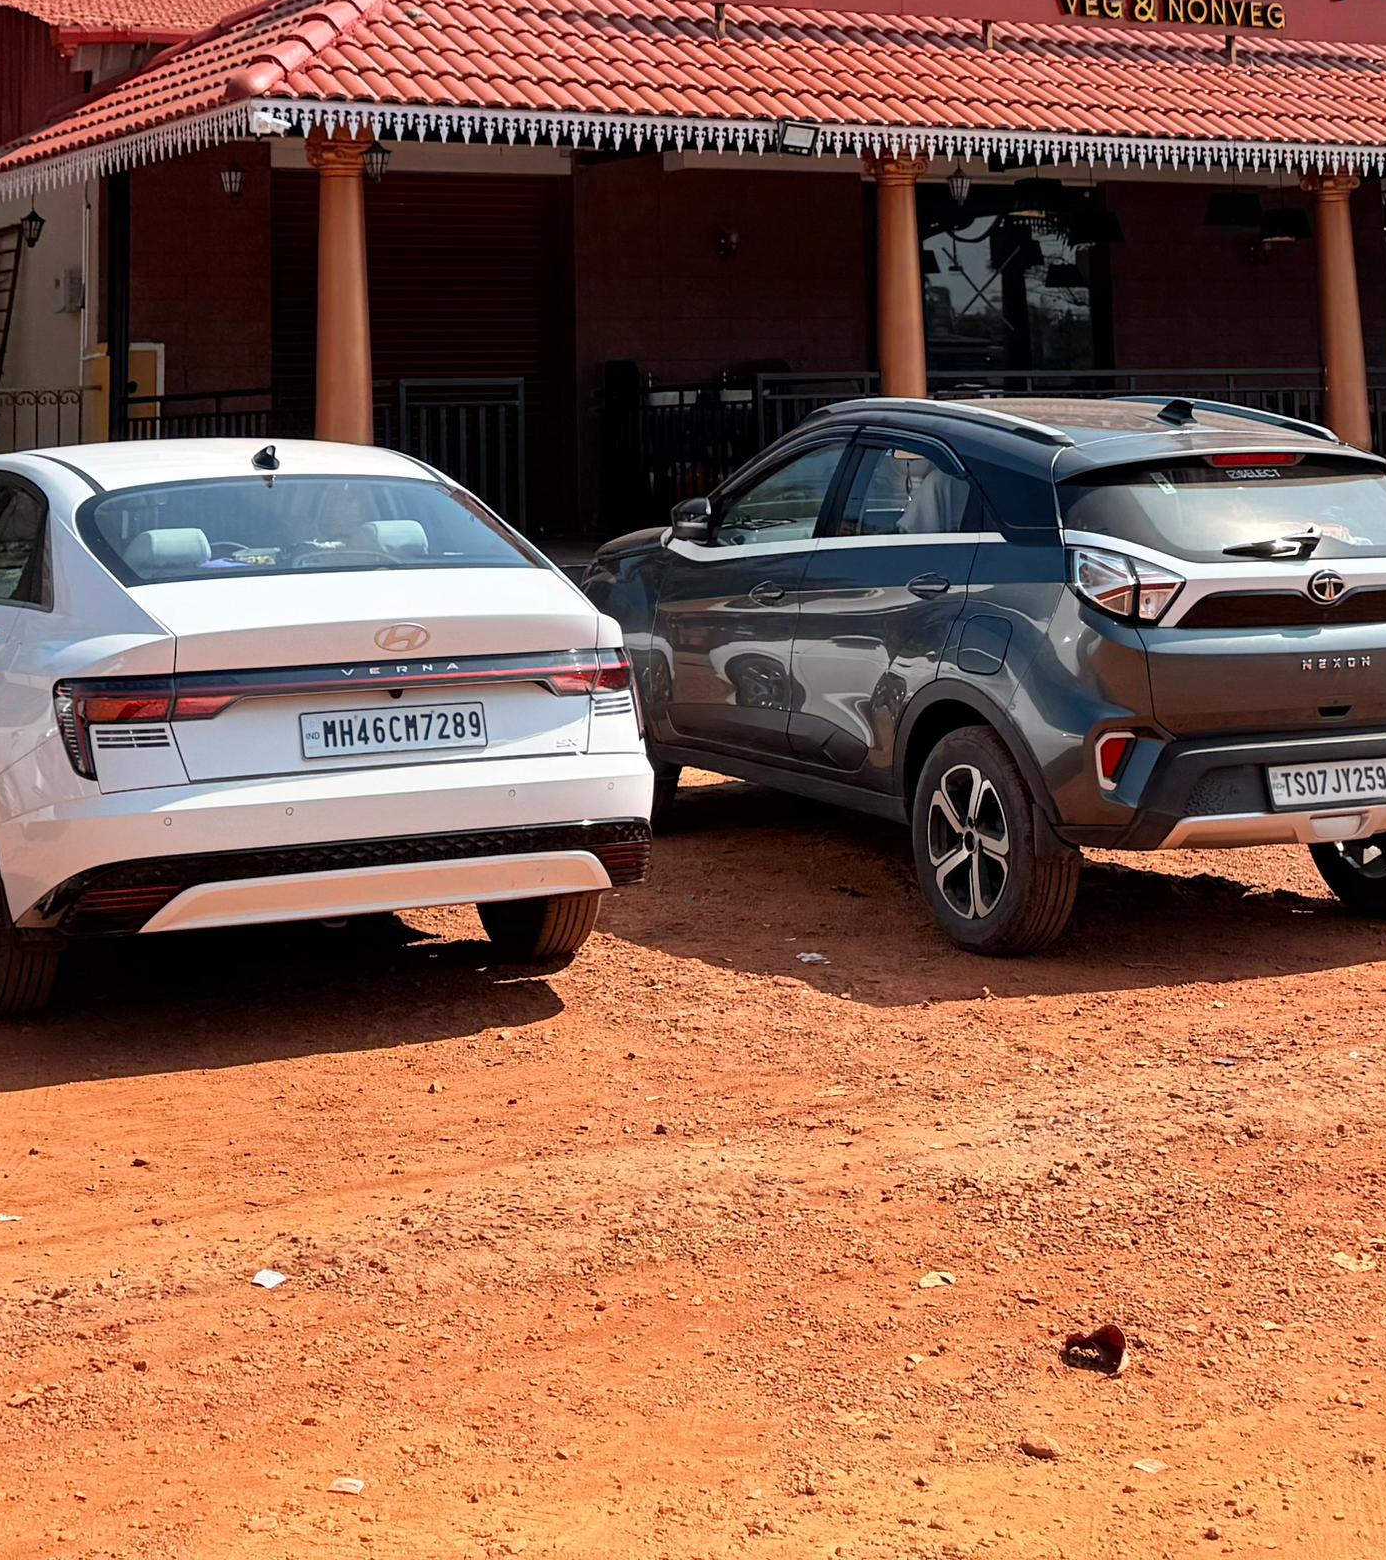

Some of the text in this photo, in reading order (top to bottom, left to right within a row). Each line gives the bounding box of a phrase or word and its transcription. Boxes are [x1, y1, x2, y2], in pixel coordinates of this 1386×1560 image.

[341, 662, 460, 676] VERNA
[1302, 655, 1371, 671] NEXON
[322, 711, 481, 748] MH46CM7289
